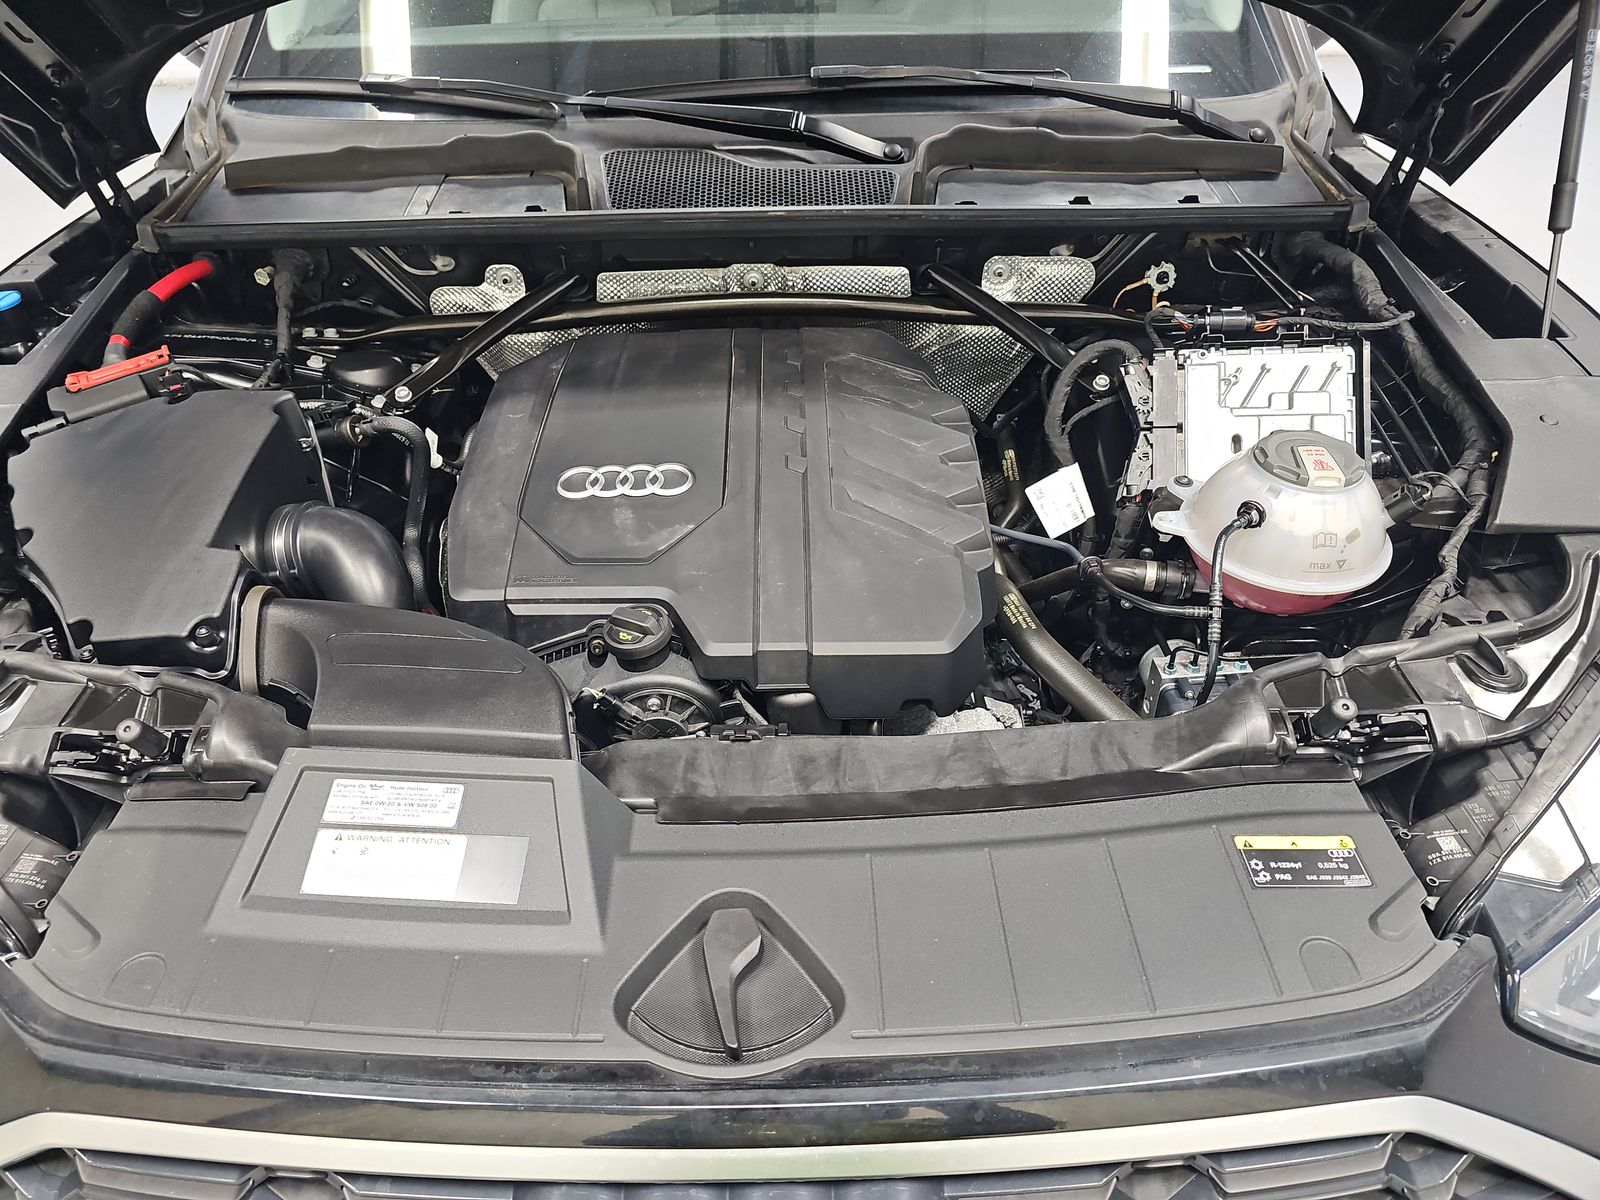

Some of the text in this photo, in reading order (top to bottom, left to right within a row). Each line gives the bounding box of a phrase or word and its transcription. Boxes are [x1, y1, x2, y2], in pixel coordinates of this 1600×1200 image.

[1309, 561, 1332, 570] max
[346, 834, 452, 846] WARNING ATTENTION
[1269, 861, 1303, 870] R-1234yf
[1338, 861, 1350, 870] kg
[1274, 873, 1293, 881] PAG
